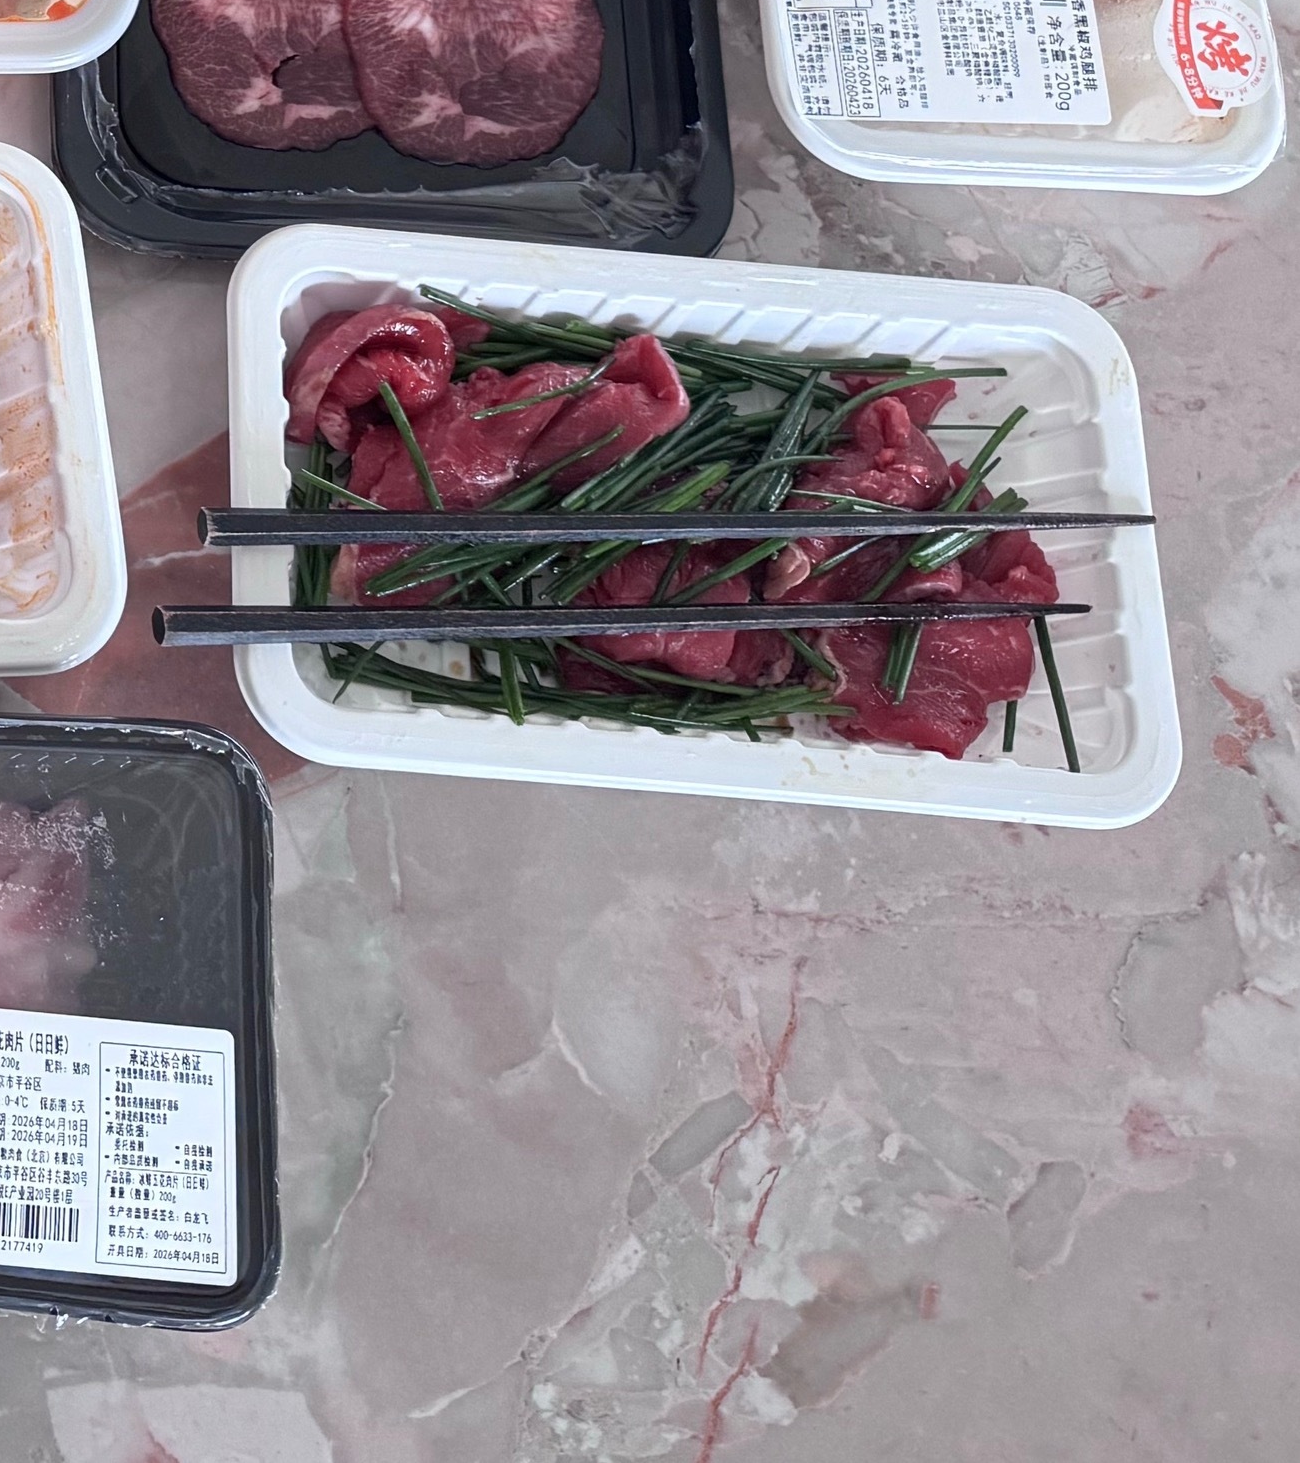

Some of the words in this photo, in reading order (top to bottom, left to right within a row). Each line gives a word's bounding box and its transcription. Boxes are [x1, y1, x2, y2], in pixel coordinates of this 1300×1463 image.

[1196, 20, 1252, 77] 烤
[129, 1049, 201, 1071] 承诺达标合格证
[0, 1239, 44, 1253] 2177419
